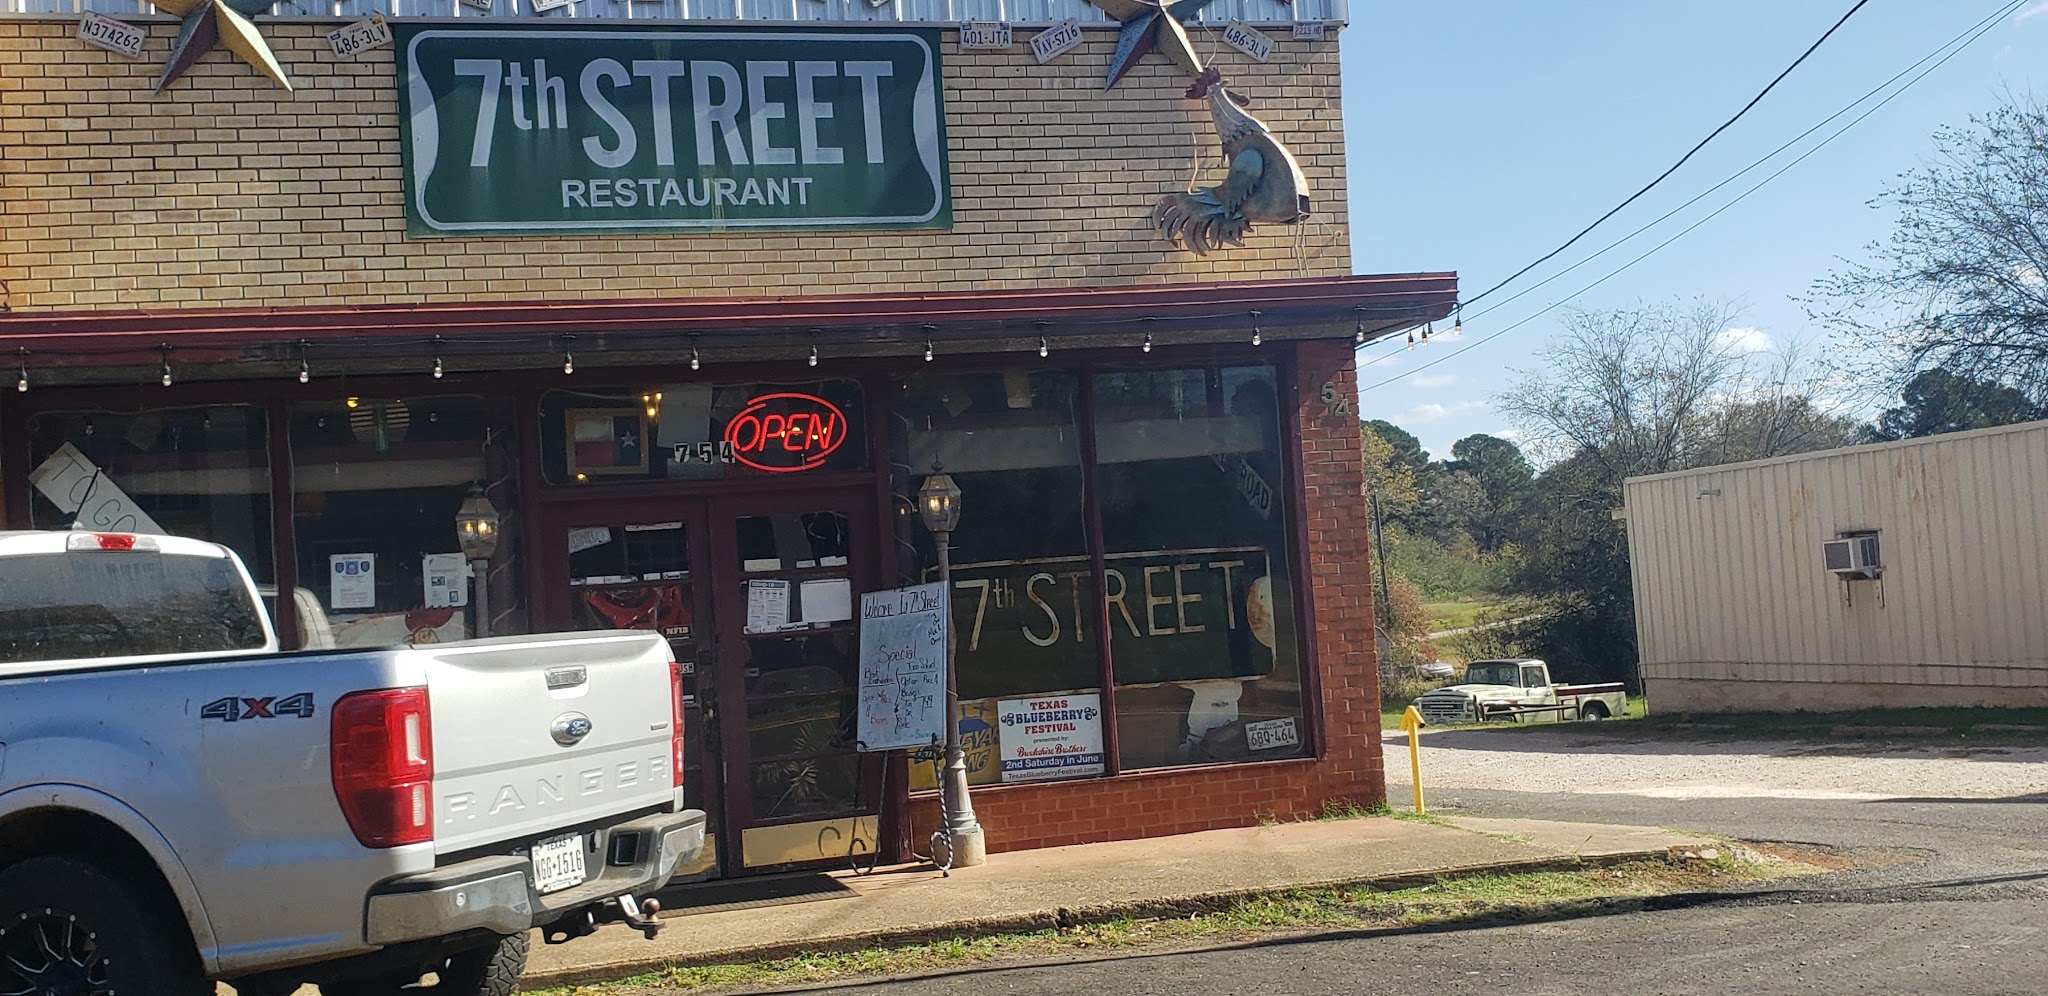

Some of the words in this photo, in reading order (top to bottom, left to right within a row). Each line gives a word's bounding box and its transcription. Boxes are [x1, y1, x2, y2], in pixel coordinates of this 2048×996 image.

[82, 19, 140, 50] N374262
[453, 58, 568, 167] 7th
[579, 57, 893, 168] STREET
[562, 177, 813, 208] RESTAURANT
[733, 413, 835, 452] OPEN
[1239, 465, 1269, 510] ROAD
[955, 578, 1015, 651] 7th
[1022, 560, 1245, 647] STREET
[666, 626, 689, 635] NFIB
[878, 640, 917, 670] Special
[1030, 700, 1068, 710] TEXAS
[1016, 709, 1083, 724] BLUEBERRY
[1025, 723, 1076, 734] FESTIVAL
[1017, 746, 1054, 757] Brookshire
[1055, 744, 1086, 755] Brothers
[1006, 760, 1023, 769] 2nd
[1025, 757, 1065, 768] Saturday
[1077, 755, 1098, 763] June
[1008, 768, 1098, 780] TexasBlueberryFestival.com
[443, 755, 668, 824] RANGER
[548, 841, 566, 851] TEXAS
